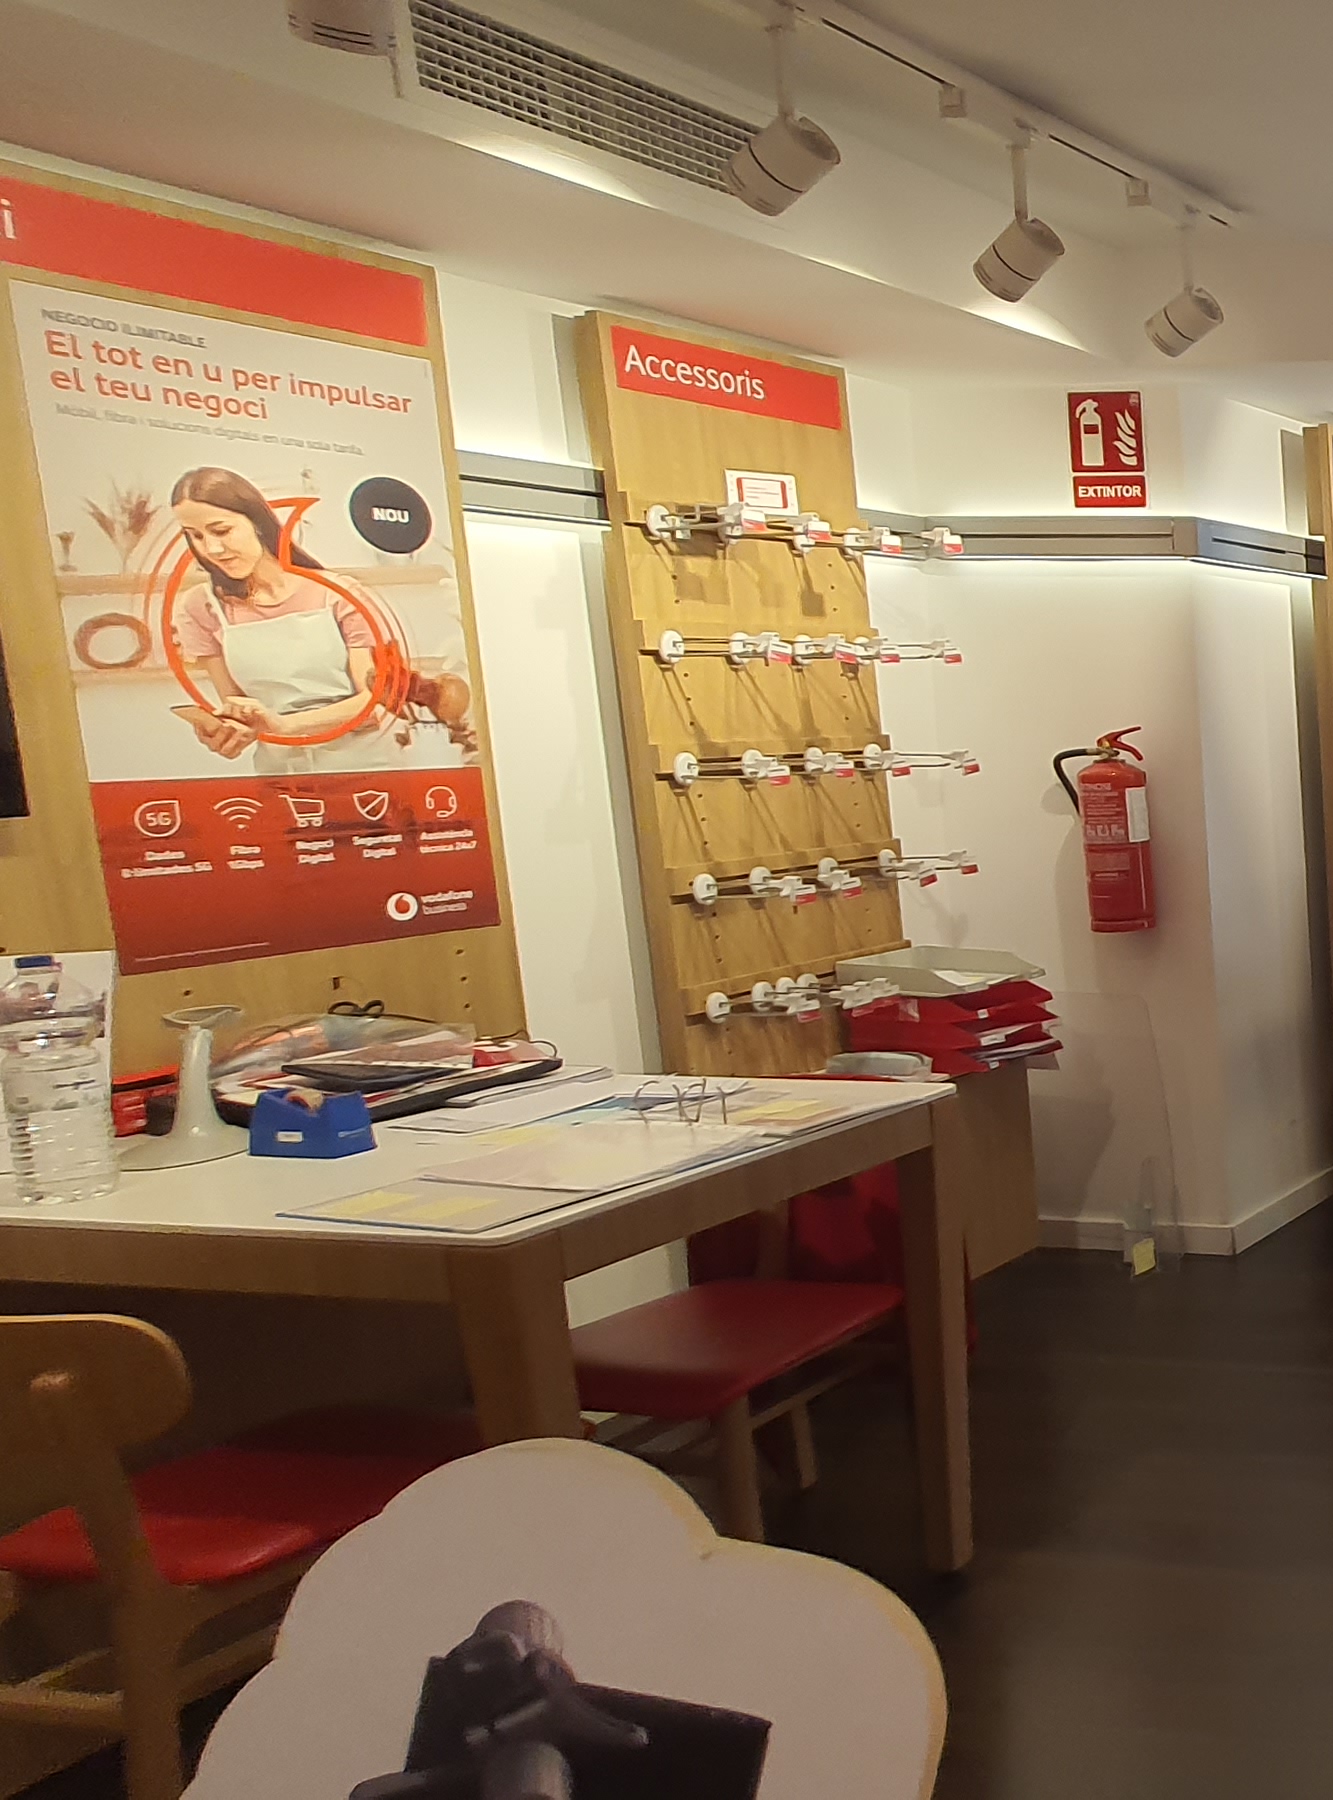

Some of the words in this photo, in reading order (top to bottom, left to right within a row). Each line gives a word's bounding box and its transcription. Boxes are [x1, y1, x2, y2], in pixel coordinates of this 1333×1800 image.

[41, 309, 118, 332] NEGOCIO
[44, 330, 84, 360] El
[92, 340, 143, 370] tot
[152, 354, 194, 378] en
[203, 363, 222, 383] u
[232, 368, 281, 391] per
[289, 373, 412, 414] impulsar
[624, 344, 766, 400] Accessoris
[50, 367, 86, 392] el
[94, 373, 152, 402] teu
[162, 387, 268, 419] negoci
[1078, 485, 1142, 498] EXTINTOR
[371, 506, 410, 524] NOU
[145, 812, 172, 827] 5G
